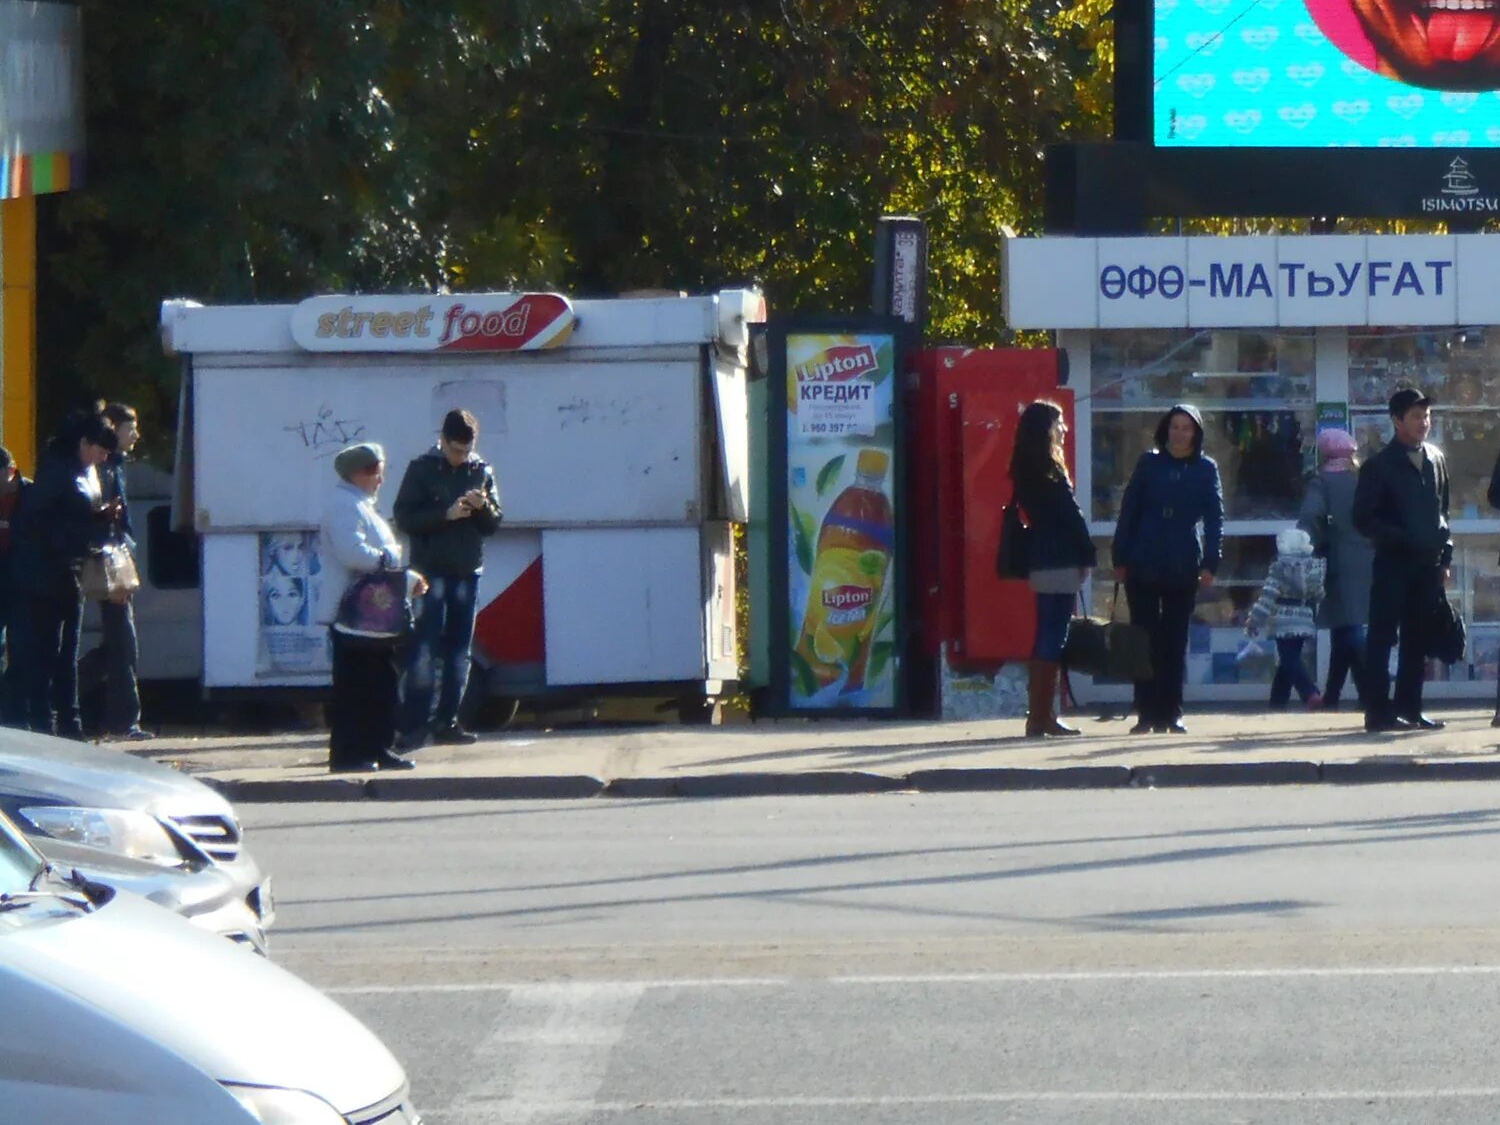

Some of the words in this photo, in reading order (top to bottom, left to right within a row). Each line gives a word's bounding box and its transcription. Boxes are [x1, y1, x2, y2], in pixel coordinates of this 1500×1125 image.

[1422, 198, 1499, 212] ISIMOTSU
[315, 305, 434, 338] street
[438, 303, 531, 346] food
[799, 352, 869, 381] Lipton
[801, 385, 871, 403] КРЕДИТ
[824, 591, 868, 607] Lipton
